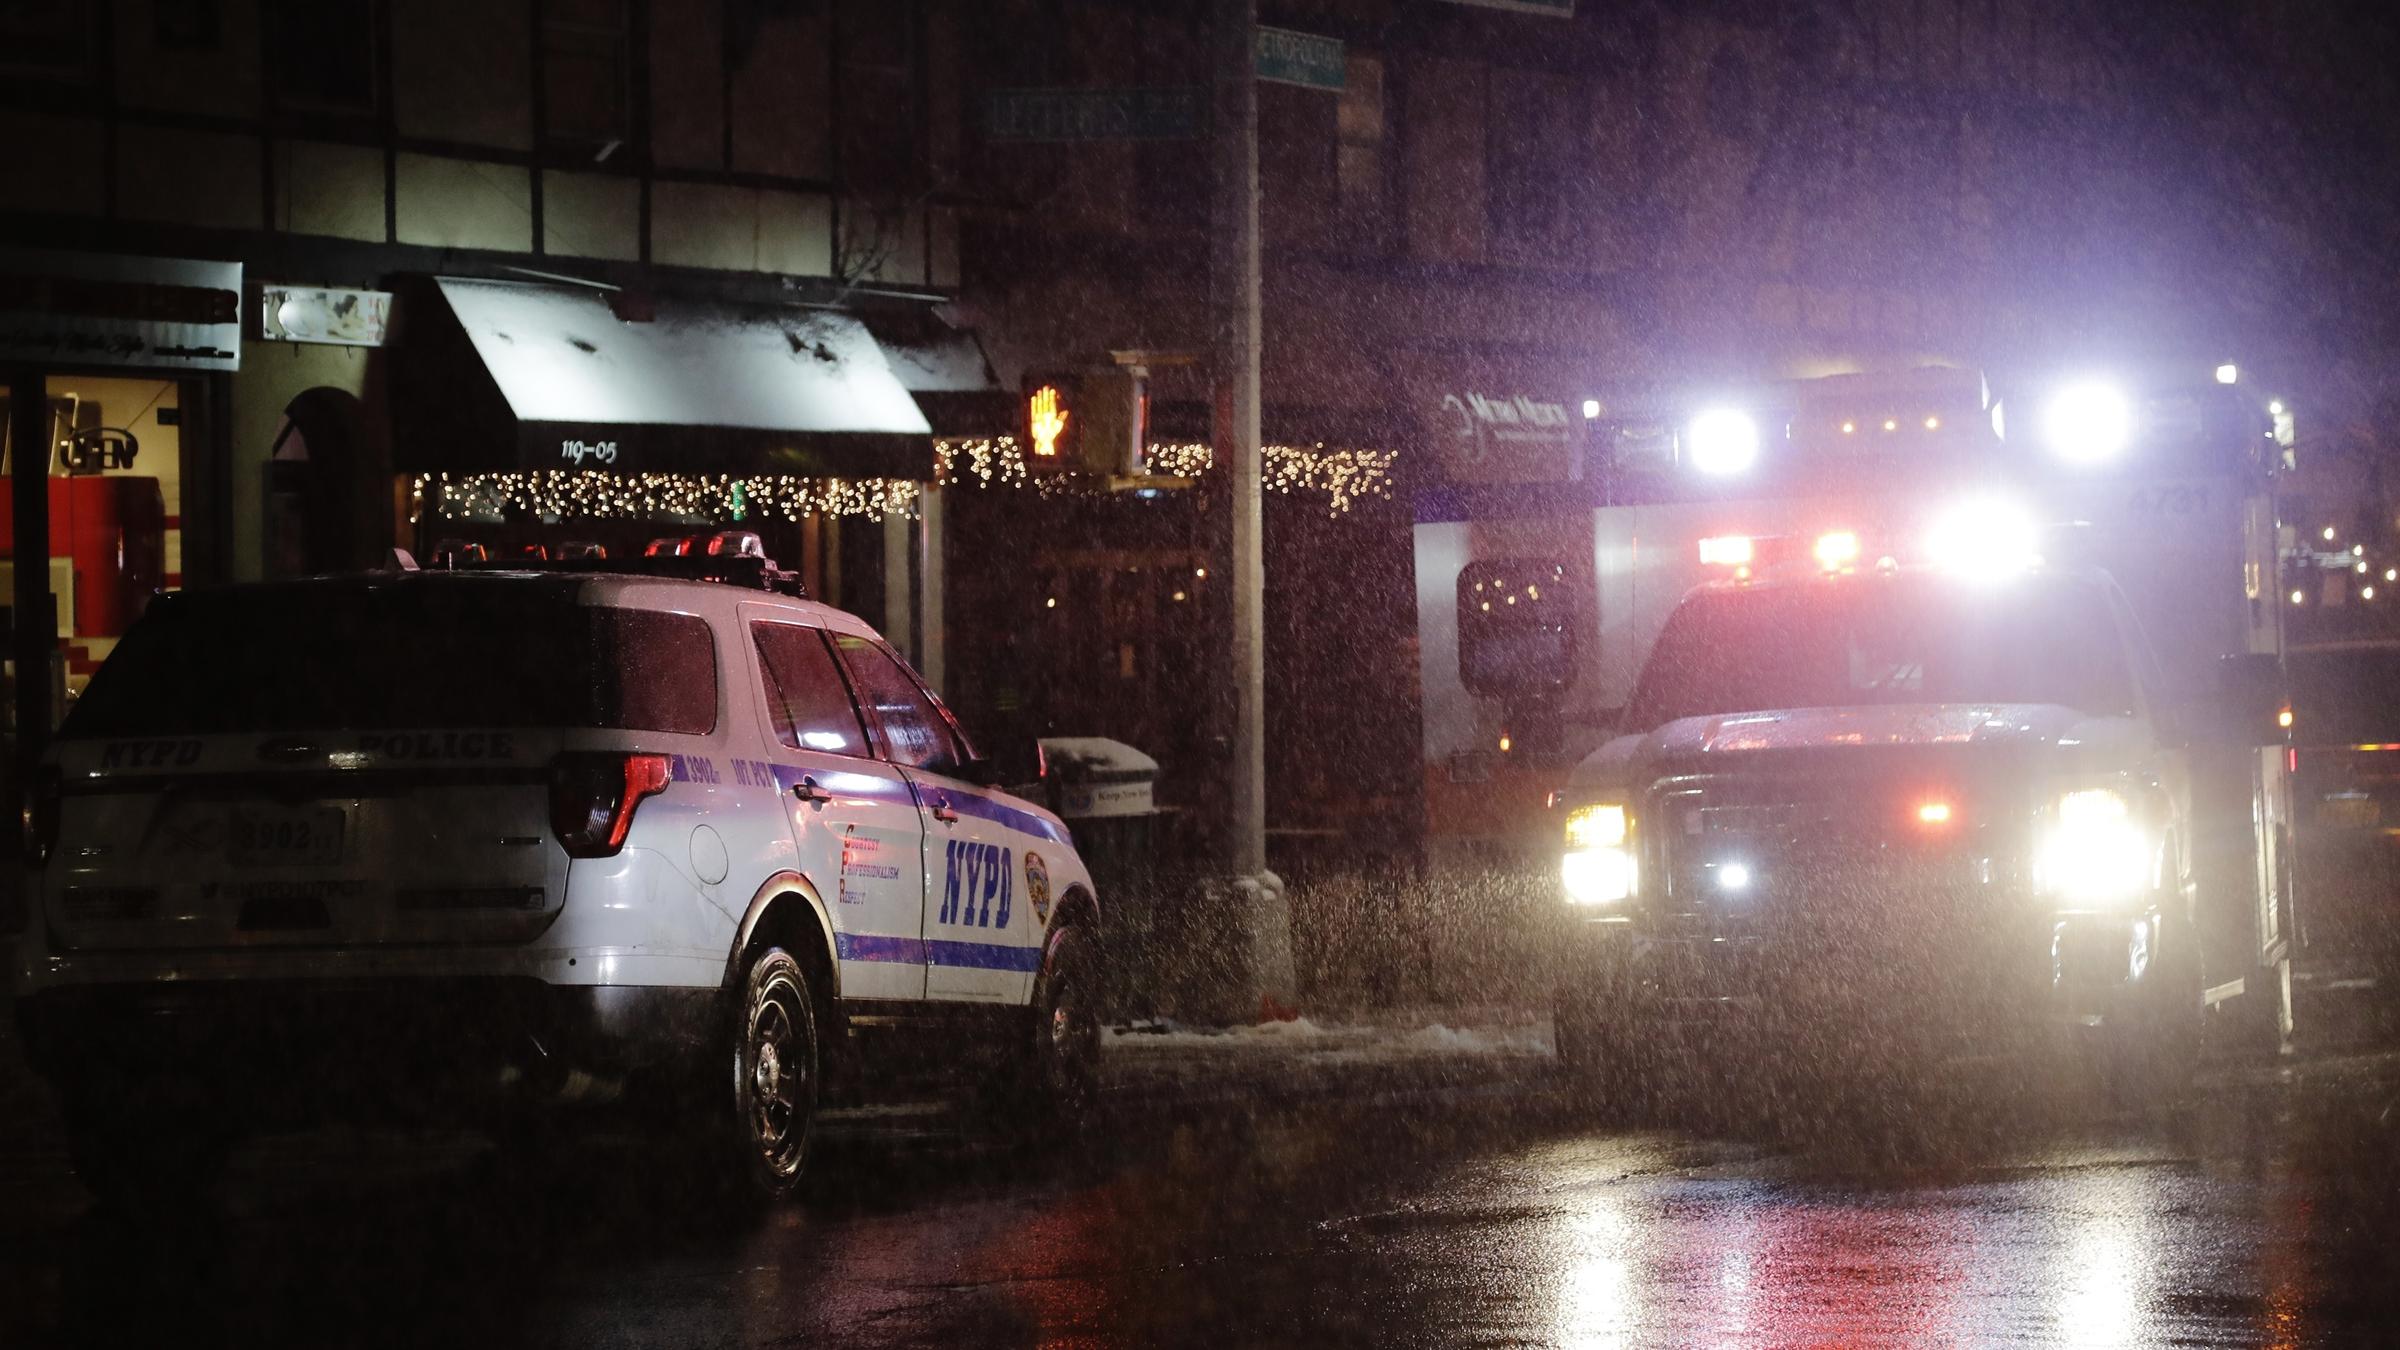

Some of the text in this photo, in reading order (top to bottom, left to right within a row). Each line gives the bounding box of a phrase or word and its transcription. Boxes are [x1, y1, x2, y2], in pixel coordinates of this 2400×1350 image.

[561, 439, 618, 465] 119-05
[102, 739, 204, 768] NYPD
[358, 732, 515, 760] POLICE
[730, 757, 752, 786] 107
[749, 760, 772, 788] PCT
[939, 839, 1012, 929] NYPD
